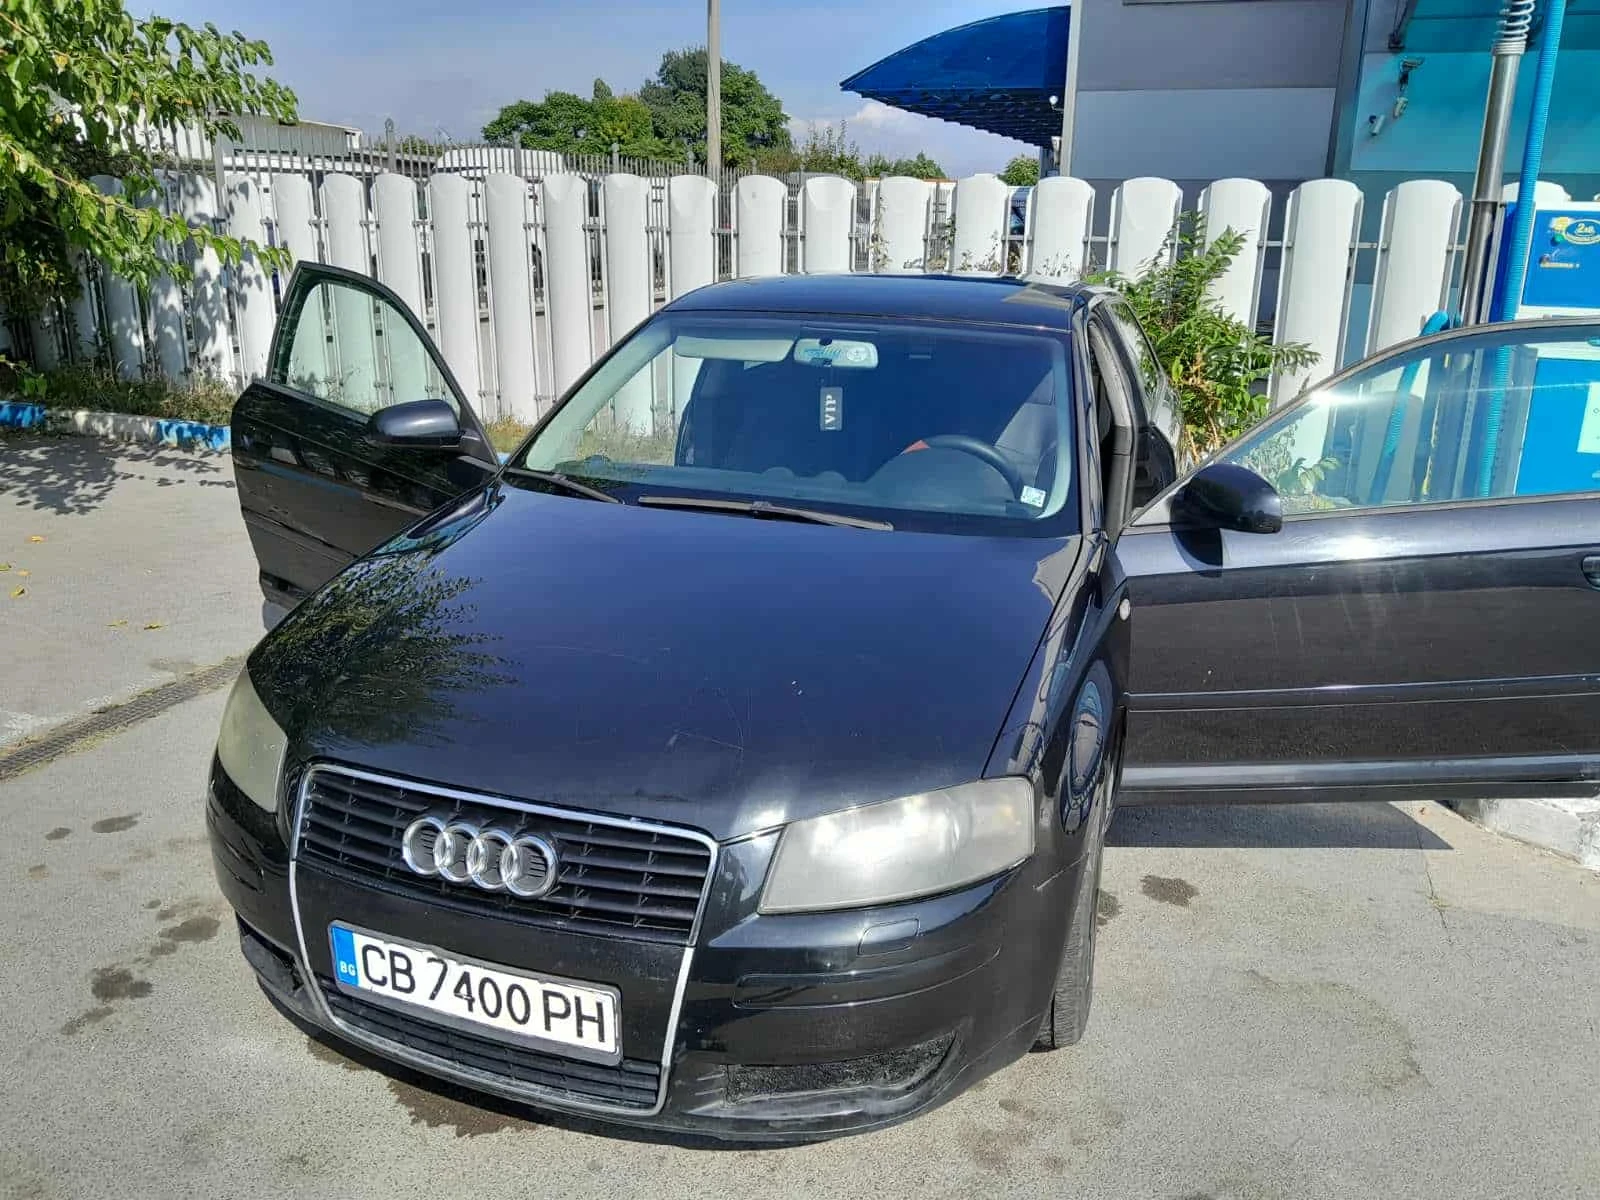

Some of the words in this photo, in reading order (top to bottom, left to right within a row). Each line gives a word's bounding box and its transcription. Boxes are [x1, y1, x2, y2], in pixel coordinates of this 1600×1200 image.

[825, 394, 837, 425] VIP
[340, 960, 356, 976] BG
[362, 944, 416, 993] CB
[427, 957, 531, 1025] 7400
[543, 990, 605, 1043] PH
